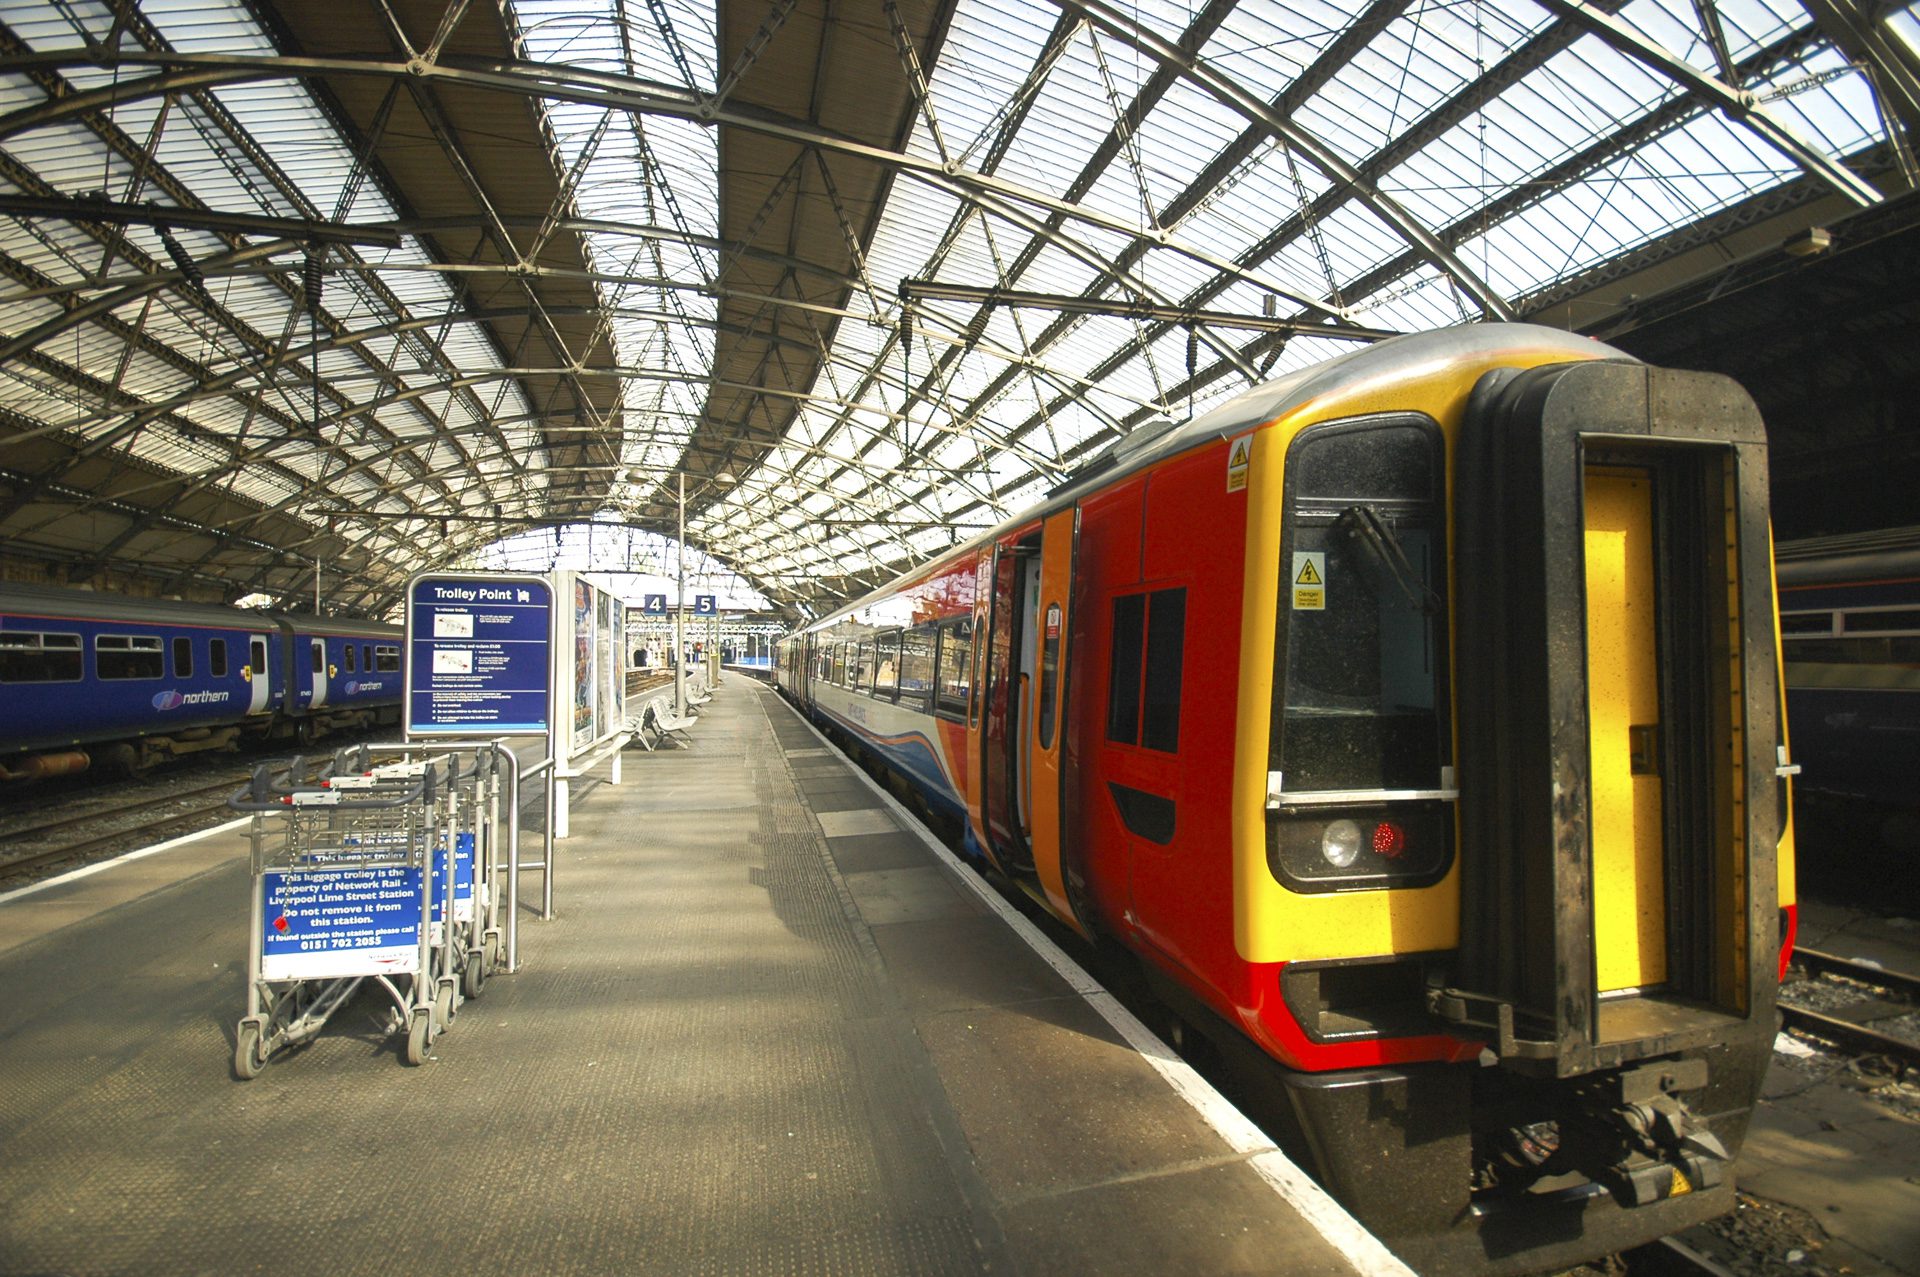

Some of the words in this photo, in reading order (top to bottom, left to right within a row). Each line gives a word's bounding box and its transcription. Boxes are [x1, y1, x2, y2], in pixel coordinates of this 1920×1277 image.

[435, 588, 477, 601] Trolley
[479, 589, 512, 600] Point
[649, 597, 661, 612] 4
[700, 597, 710, 612] 5
[183, 688, 229, 705] northern
[280, 873, 301, 882] This
[304, 872, 341, 883] luggage
[344, 870, 376, 880] trolley
[378, 870, 386, 878] is
[388, 869, 404, 877] the
[275, 884, 319, 895] property
[322, 882, 333, 891] of
[335, 881, 379, 891] Network
[382, 880, 401, 888] Rail
[319, 893, 344, 902] Lime
[346, 891, 377, 901] Street
[379, 890, 414, 900] Station
[283, 909, 298, 917] Do
[300, 907, 320, 916] not
[322, 906, 362, 915] remove
[365, 904, 374, 912] it
[376, 903, 401, 912] from
[310, 918, 331, 927] this
[333, 916, 374, 925] station.
[275, 933, 299, 942] found
[301, 931, 330, 940] outside
[331, 930, 344, 938] the
[347, 929, 374, 937] station
[375, 927, 400, 936] please
[401, 926, 414, 934] call
[300, 940, 327, 951] 0151
[331, 938, 353, 948] 702
[355, 936, 382, 947] 2055
